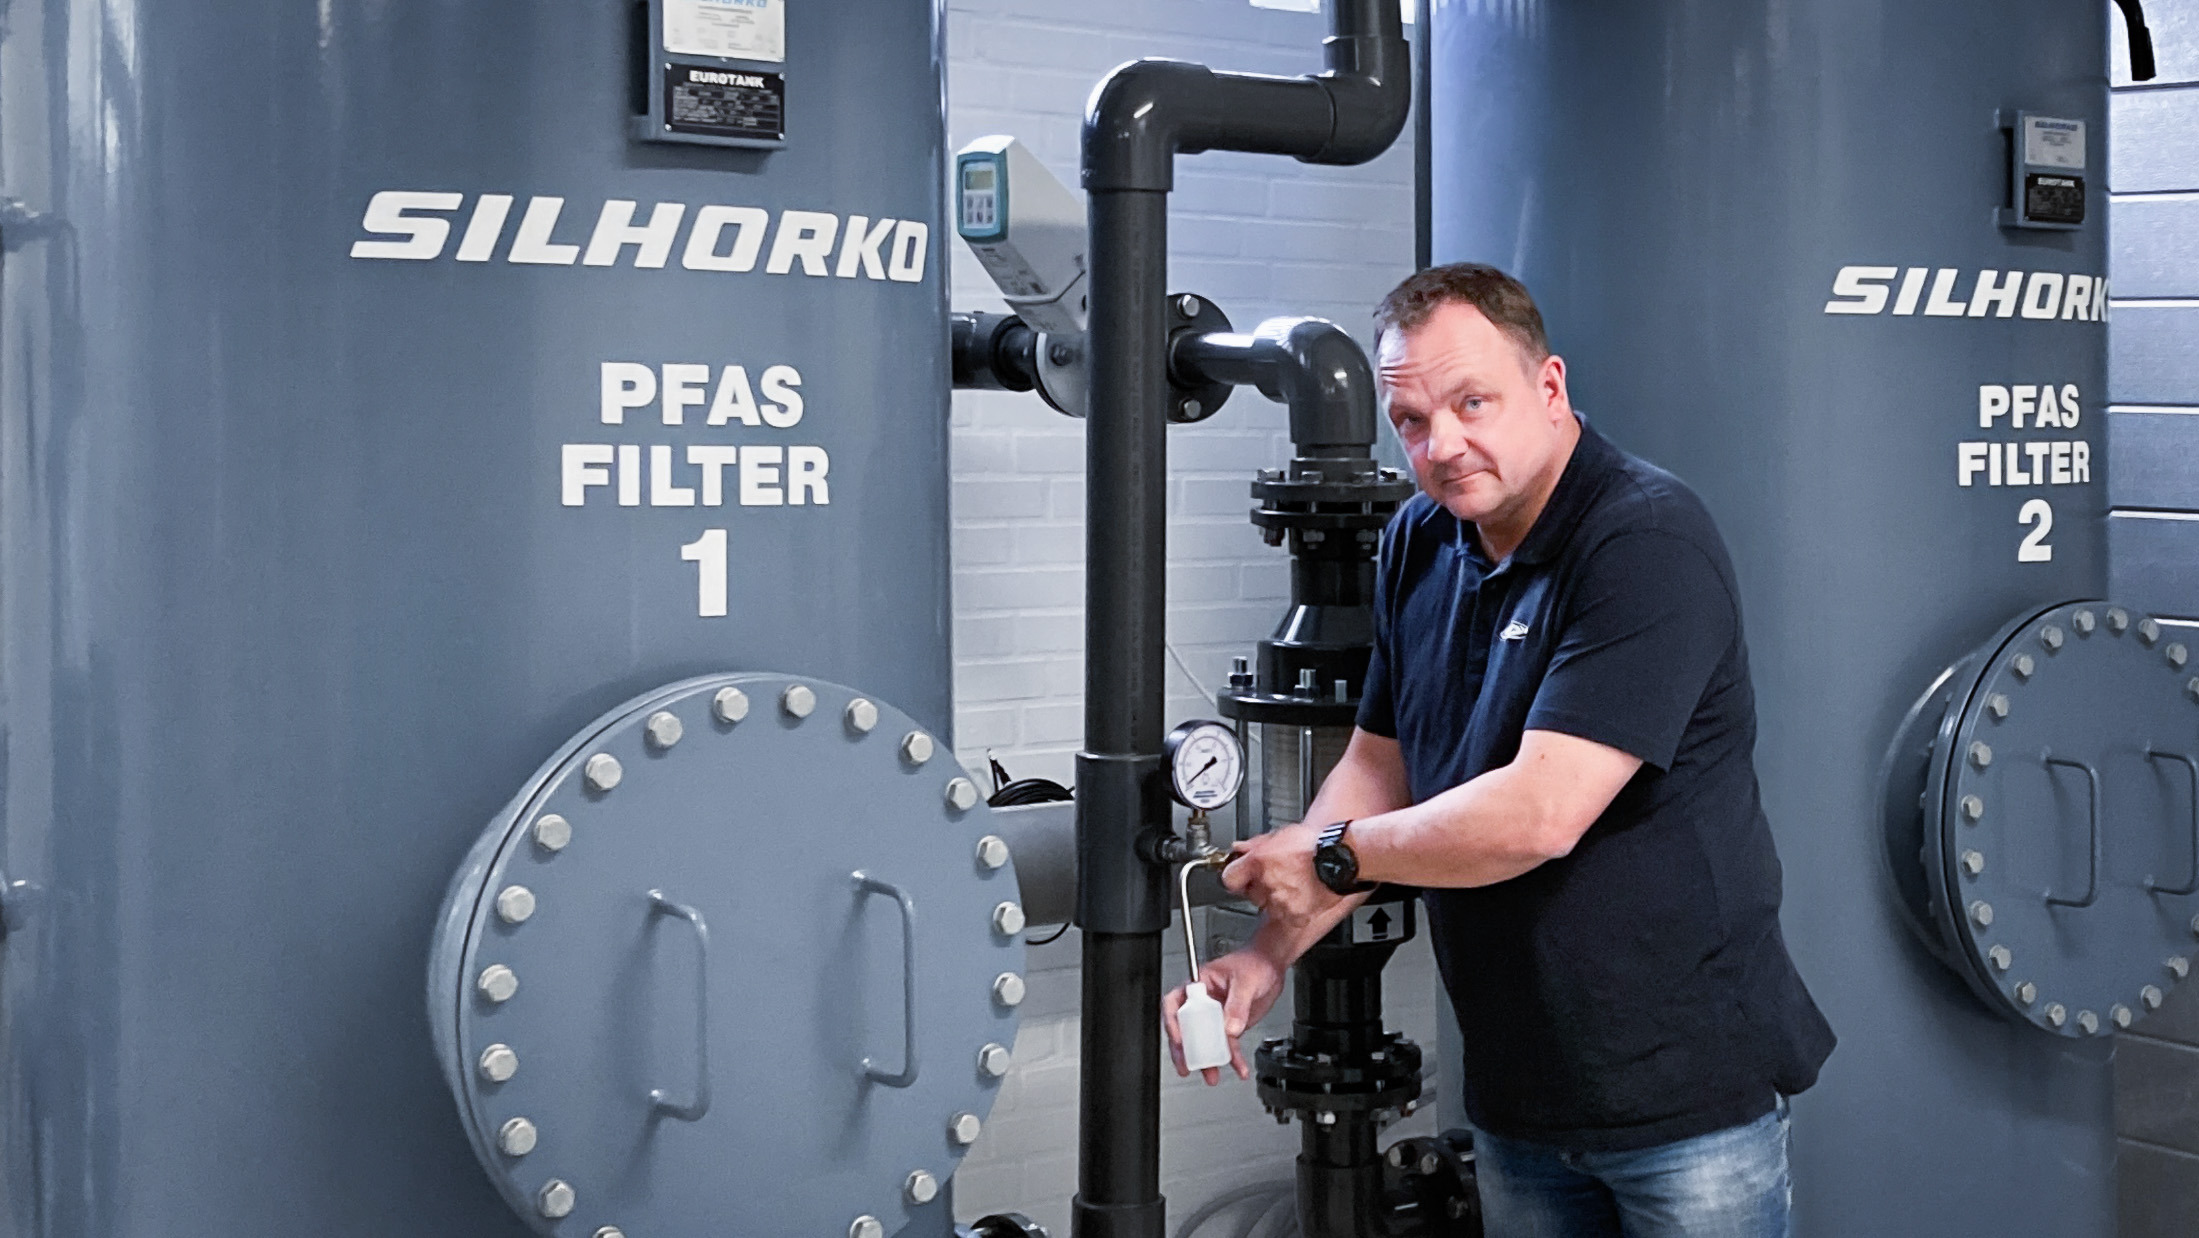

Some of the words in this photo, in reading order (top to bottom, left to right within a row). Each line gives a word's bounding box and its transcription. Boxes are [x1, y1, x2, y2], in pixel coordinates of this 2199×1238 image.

[350, 191, 928, 283] SILHORKO
[600, 362, 804, 428] PFAS
[1979, 383, 2080, 429] PFAS
[561, 444, 830, 507] FILTER
[1958, 441, 2090, 486] FILTER
[2017, 498, 2053, 562] 2
[680, 528, 728, 617] 1
